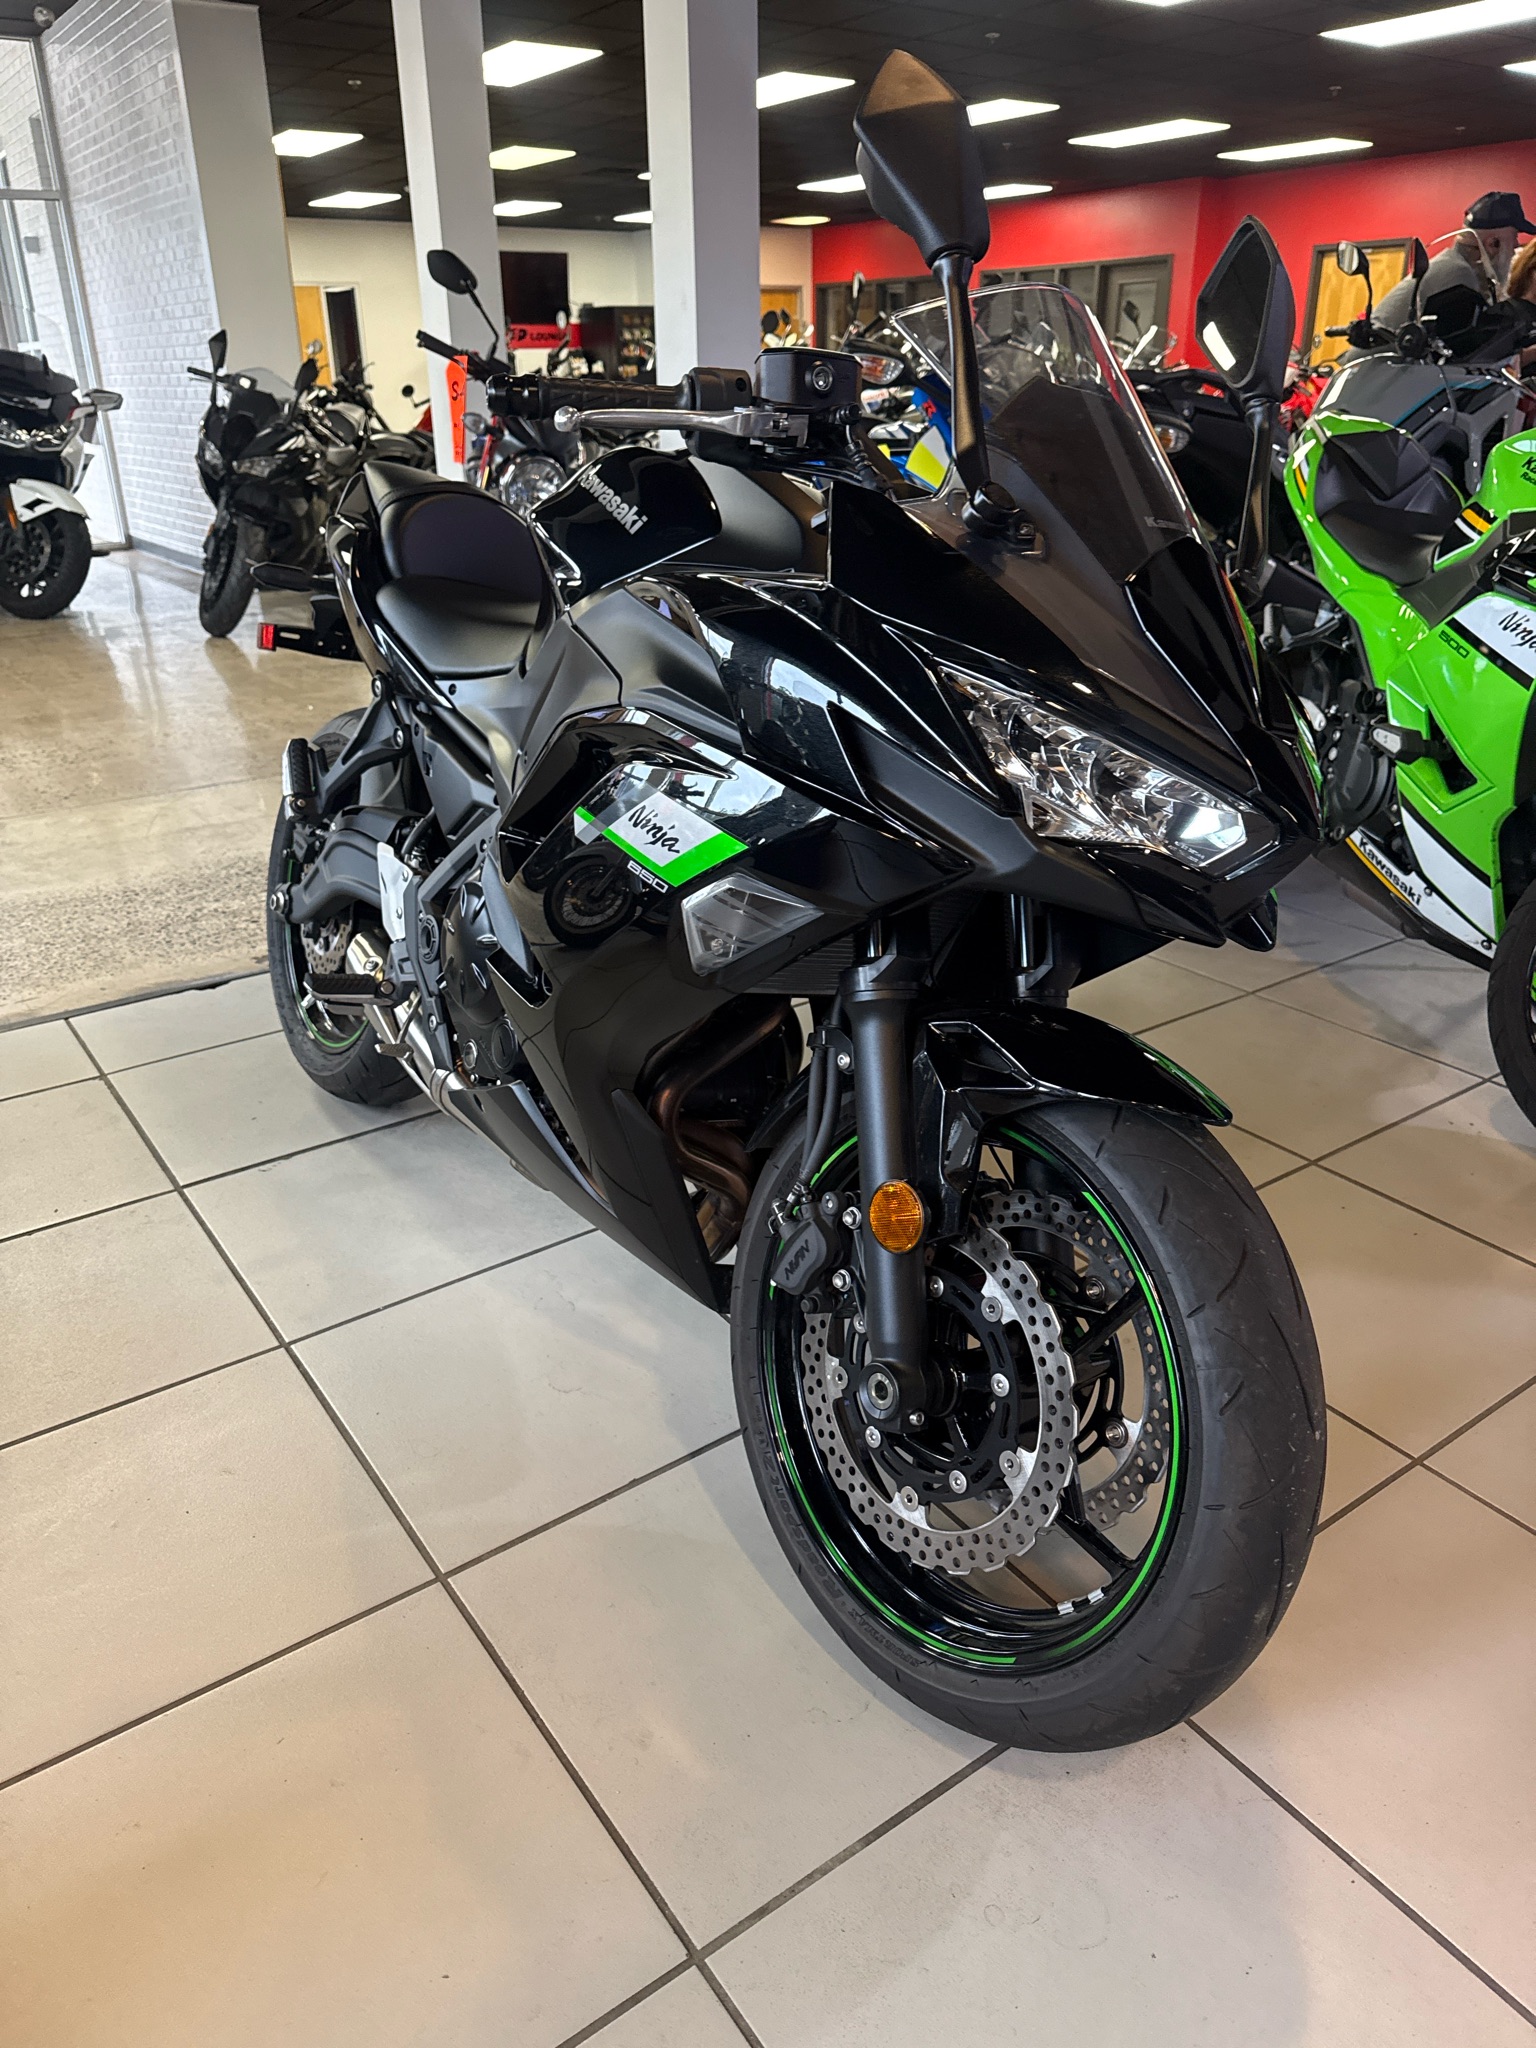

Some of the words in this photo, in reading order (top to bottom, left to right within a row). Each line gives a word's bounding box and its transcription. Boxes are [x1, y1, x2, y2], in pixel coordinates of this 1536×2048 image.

[578, 464, 649, 535] Kawasaki
[1439, 630, 1470, 659] 500
[628, 805, 681, 853] Ninja
[627, 860, 669, 893] 650
[1360, 837, 1422, 906] Kawasaki
